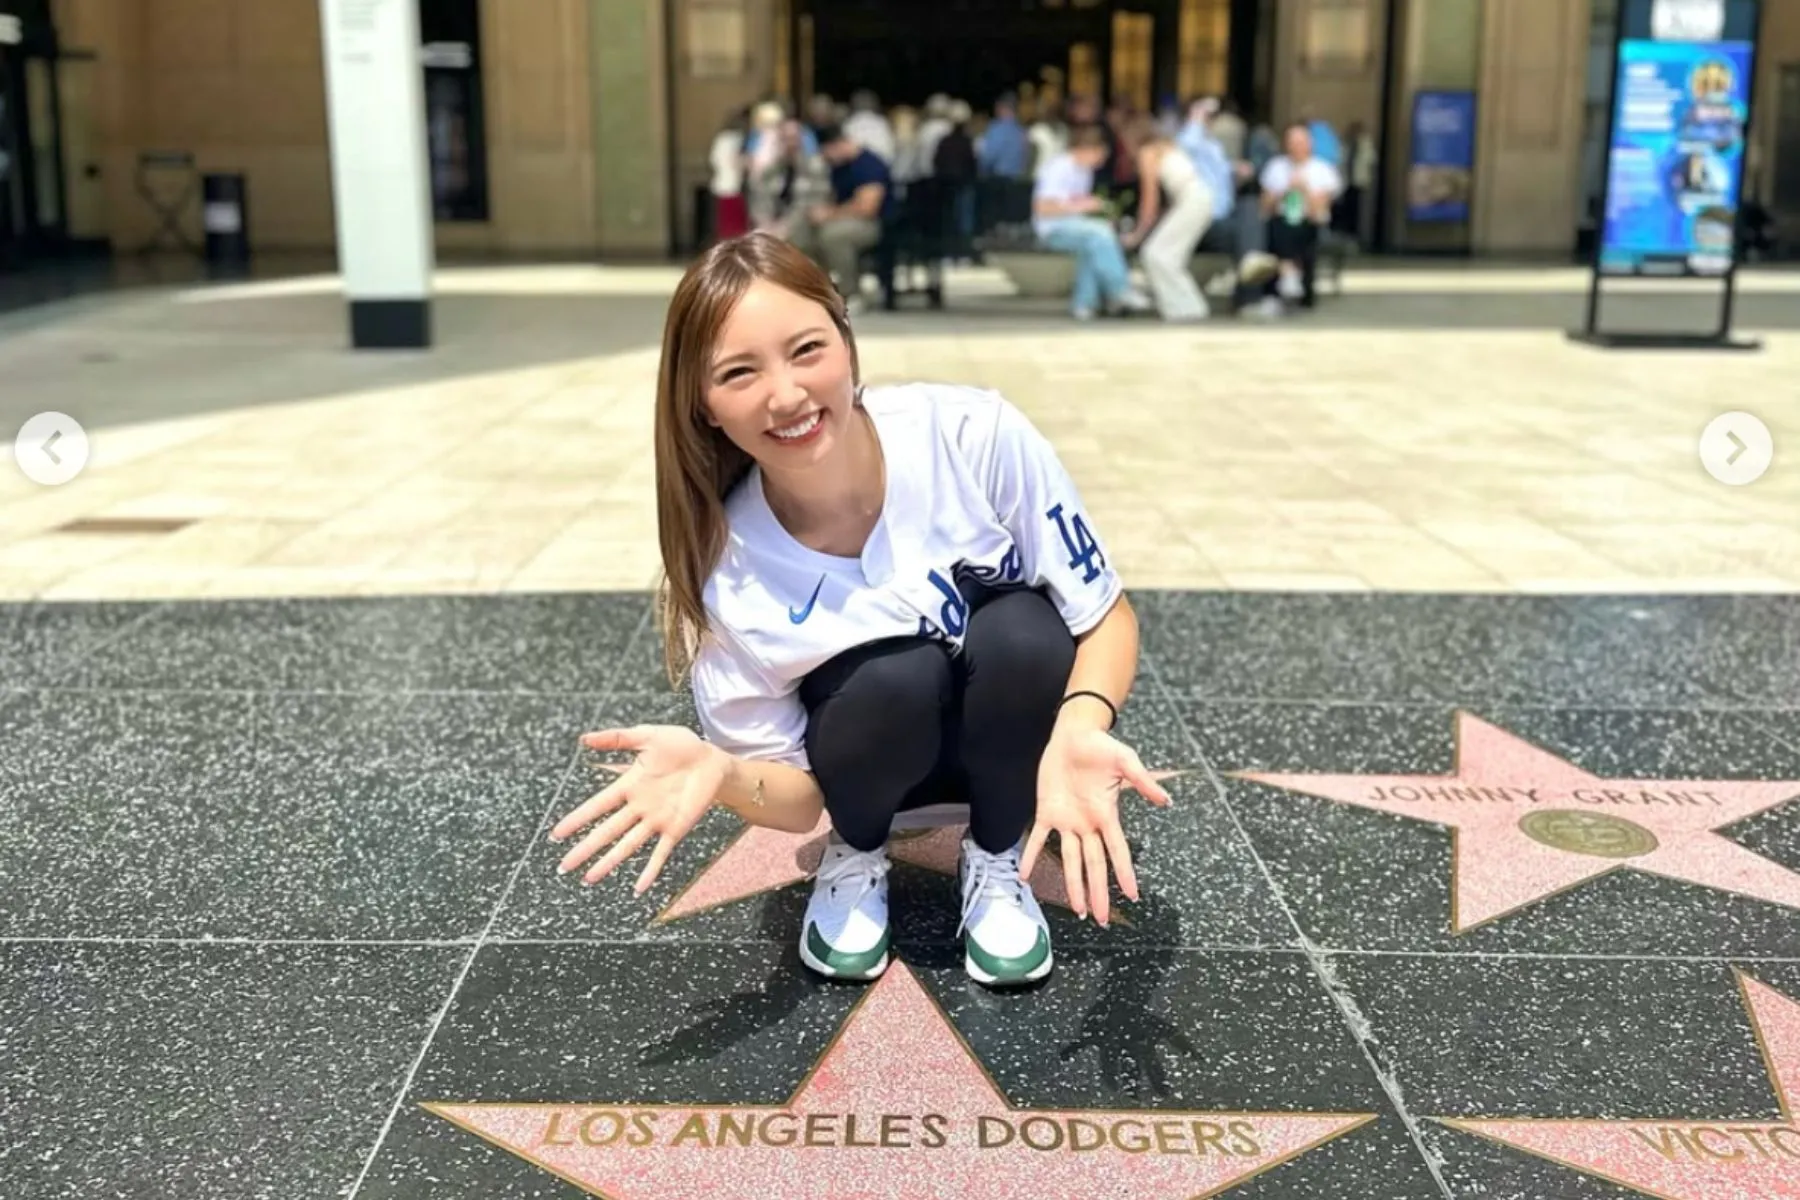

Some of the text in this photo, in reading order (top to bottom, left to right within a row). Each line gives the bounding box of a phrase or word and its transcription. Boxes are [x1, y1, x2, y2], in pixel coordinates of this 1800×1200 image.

[1046, 503, 1106, 584] LA
[1369, 785, 1724, 808] JOHNNY GRANT
[544, 1112, 1262, 1157] LOS ANGELES DODGERS
